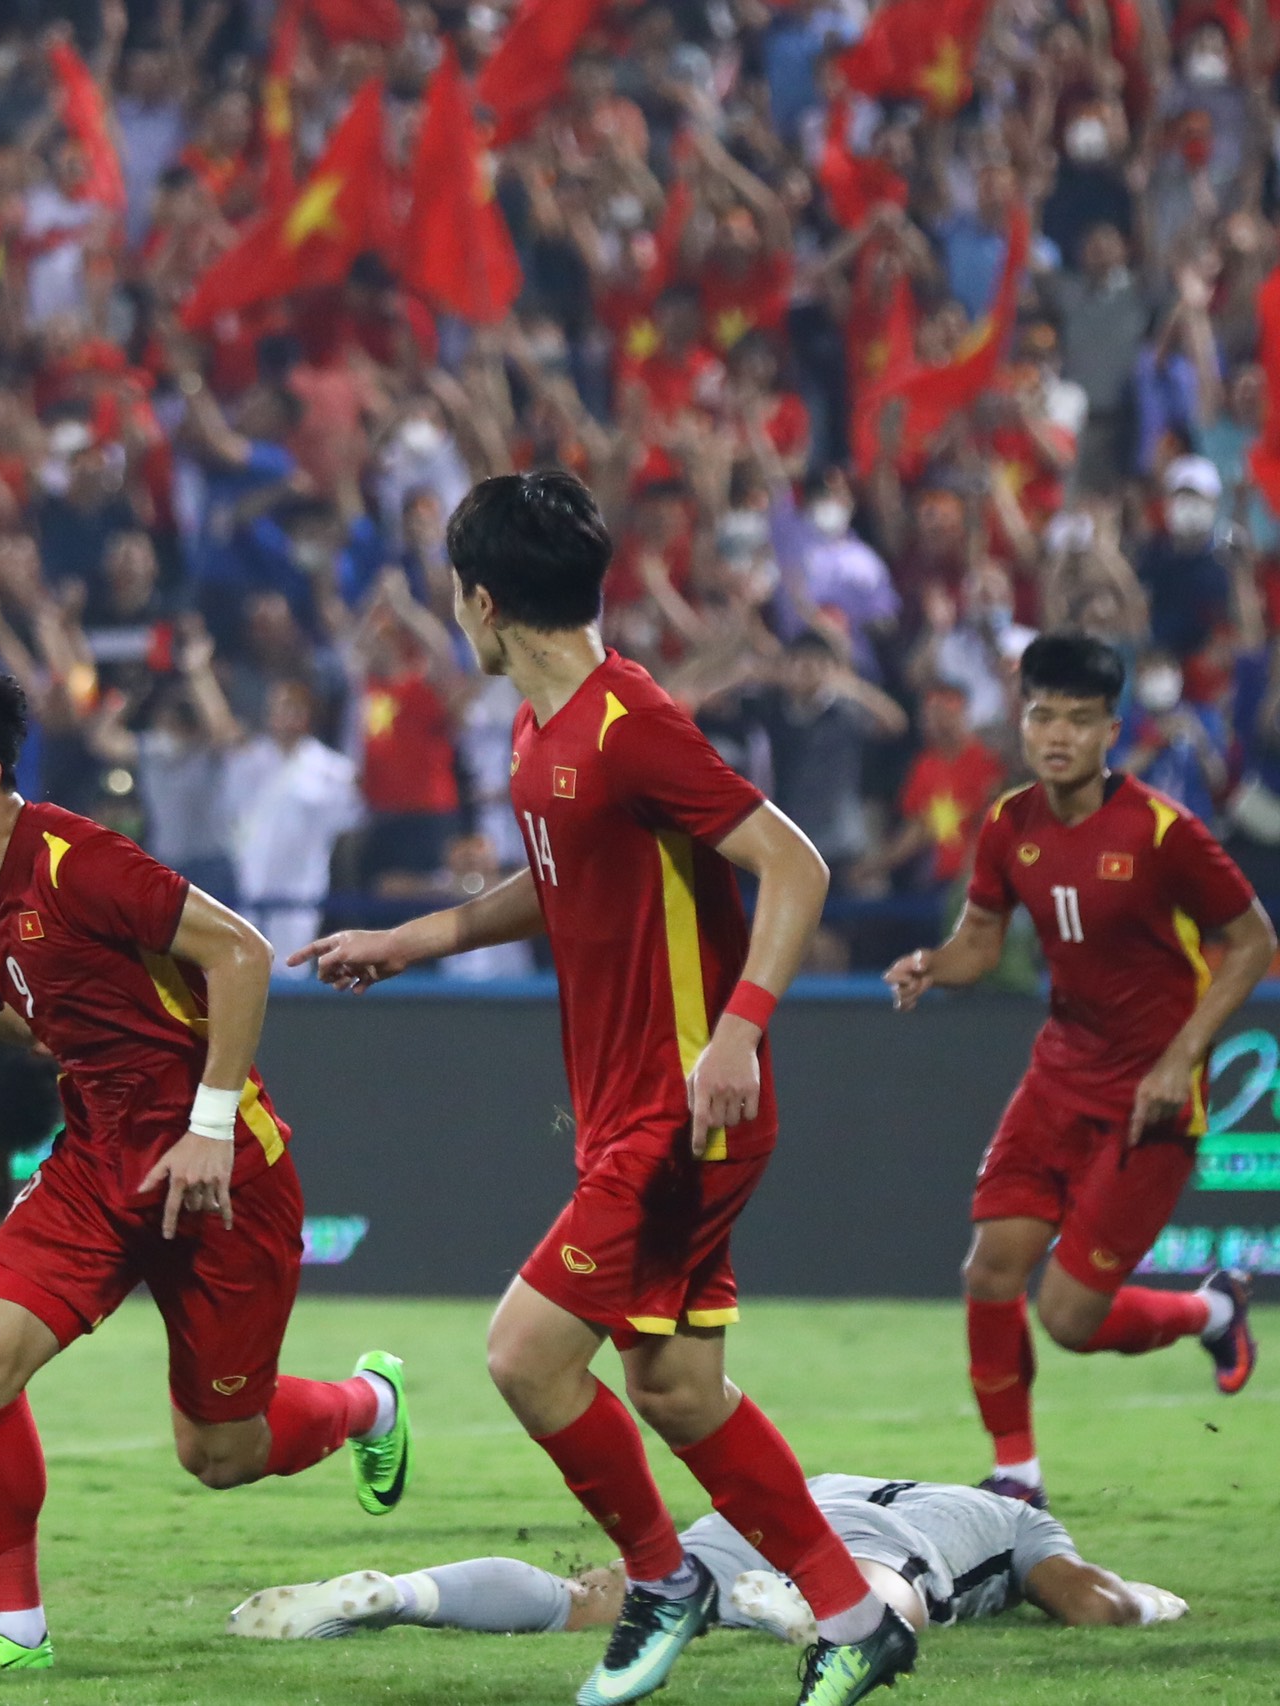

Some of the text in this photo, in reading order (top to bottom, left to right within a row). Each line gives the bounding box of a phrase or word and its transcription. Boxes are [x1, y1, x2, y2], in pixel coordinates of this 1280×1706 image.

[524, 811, 558, 887] 14
[1051, 885, 1085, 943] 11
[6, 956, 34, 1018] 9
